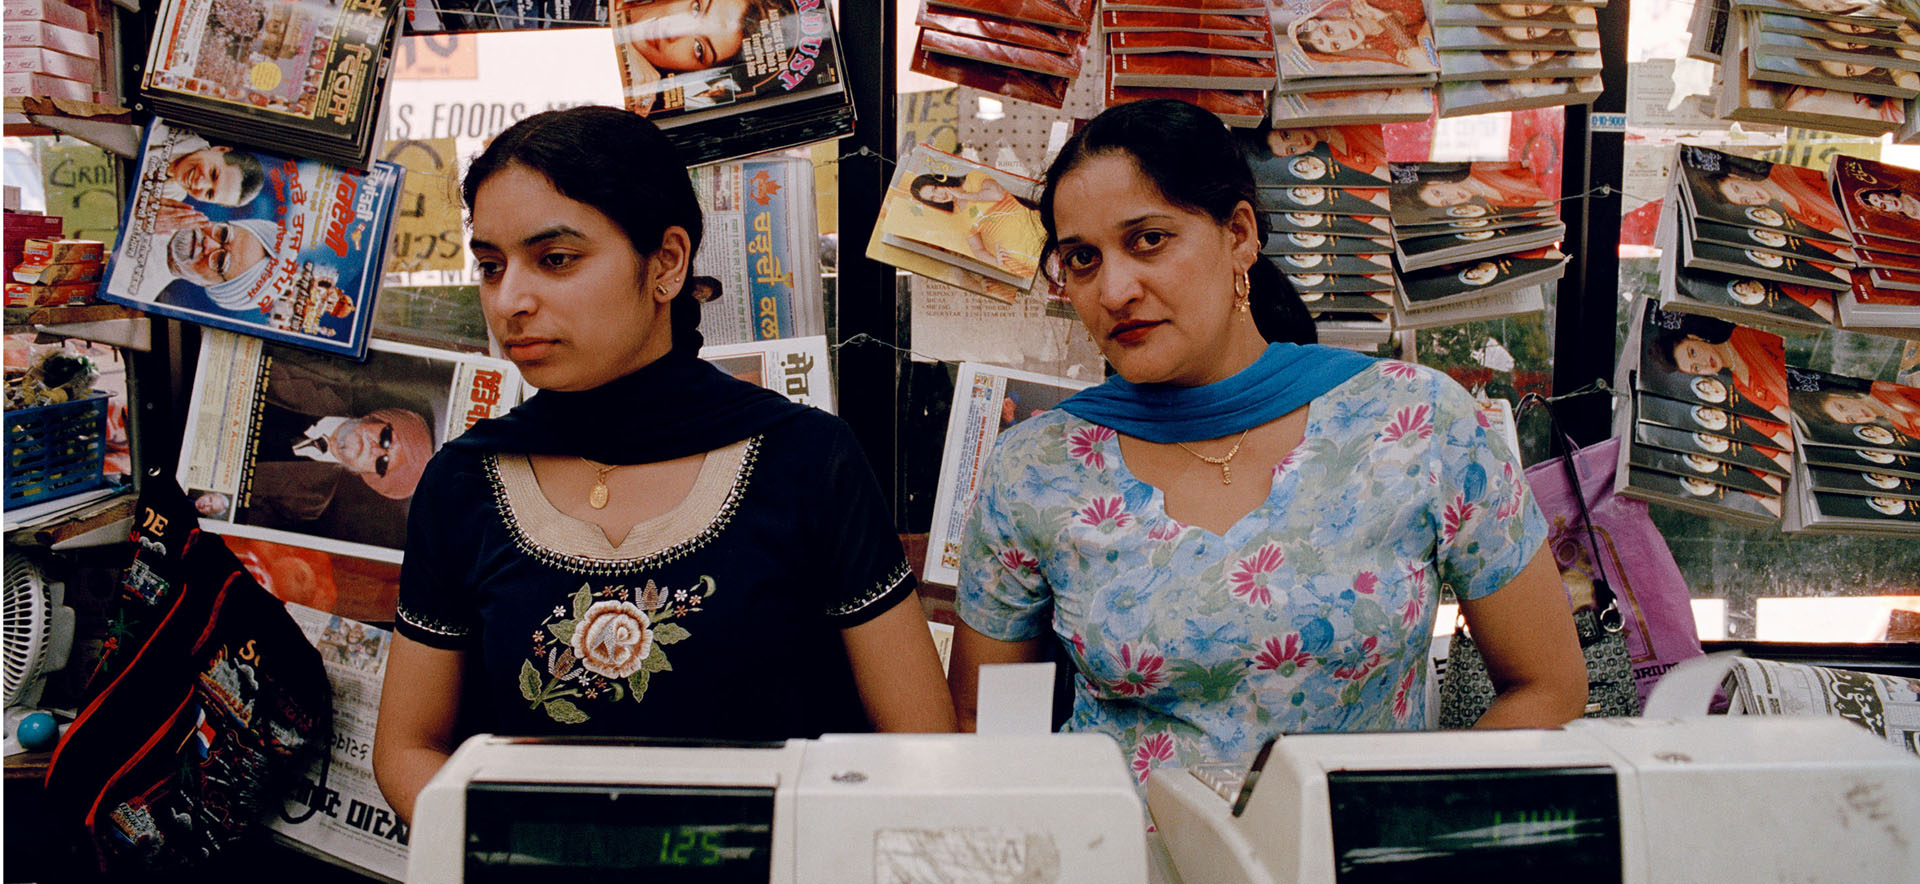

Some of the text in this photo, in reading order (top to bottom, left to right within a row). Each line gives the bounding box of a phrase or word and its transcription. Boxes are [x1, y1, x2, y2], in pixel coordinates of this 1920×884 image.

[780, 0, 824, 92] RDUST
[758, 296, 781, 340] ਕਲ
[779, 351, 814, 404] ਸ਼ੇਰ-
[659, 832, 722, 866] 1.25
